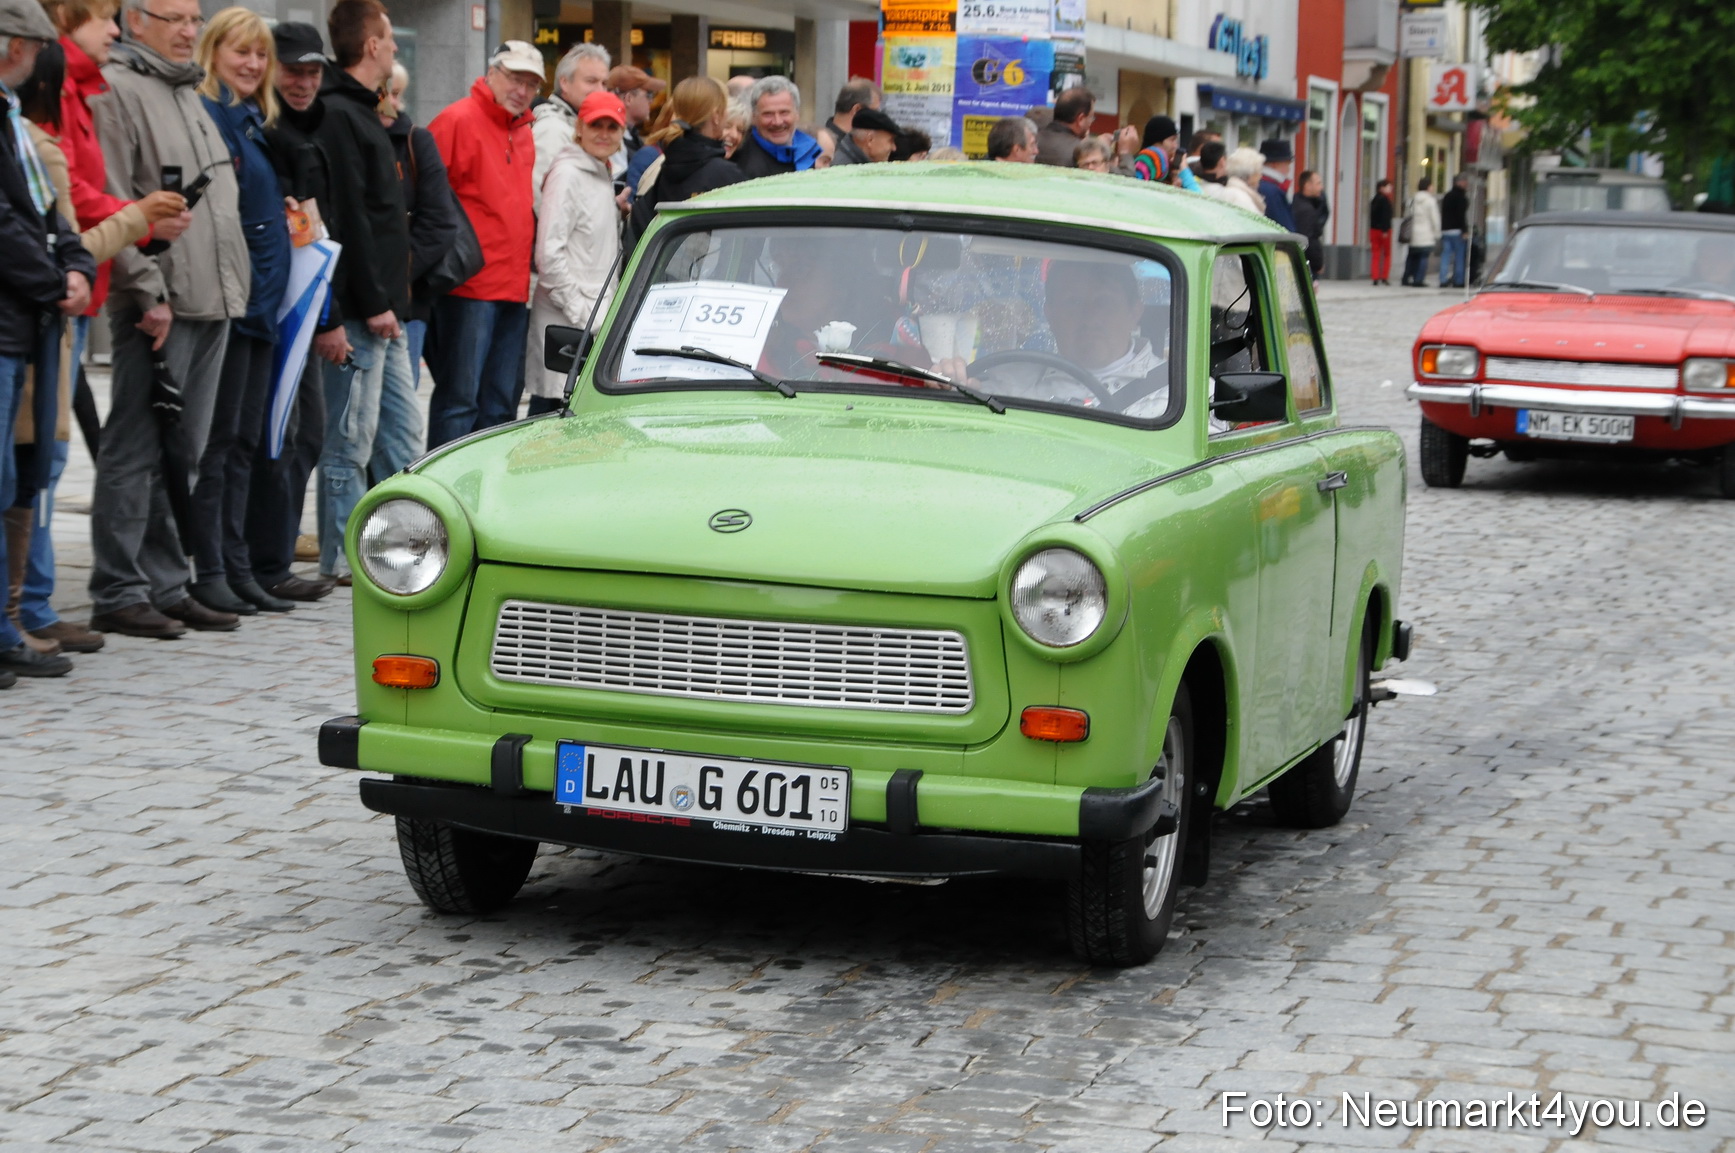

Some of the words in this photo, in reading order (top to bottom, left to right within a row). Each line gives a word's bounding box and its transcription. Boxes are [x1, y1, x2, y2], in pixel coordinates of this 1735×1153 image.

[963, 4, 999, 17] 25.6.
[711, 30, 766, 48] FRIES
[931, 83, 951, 92] 2013
[696, 304, 745, 326] 355
[1529, 413, 1549, 431] NM
[1563, 416, 1583, 434] EK
[1589, 418, 1633, 437] 500H
[565, 780, 575, 793] D
[586, 753, 665, 806] LAU
[699, 765, 724, 811] G
[737, 770, 813, 821] 601
[820, 776, 839, 790] 05
[587, 808, 691, 827] PORSCHE
[820, 809, 838, 823] 10
[713, 821, 750, 833] Chemnitz
[762, 826, 795, 837] Dresden
[807, 830, 837, 841] Leipzig
